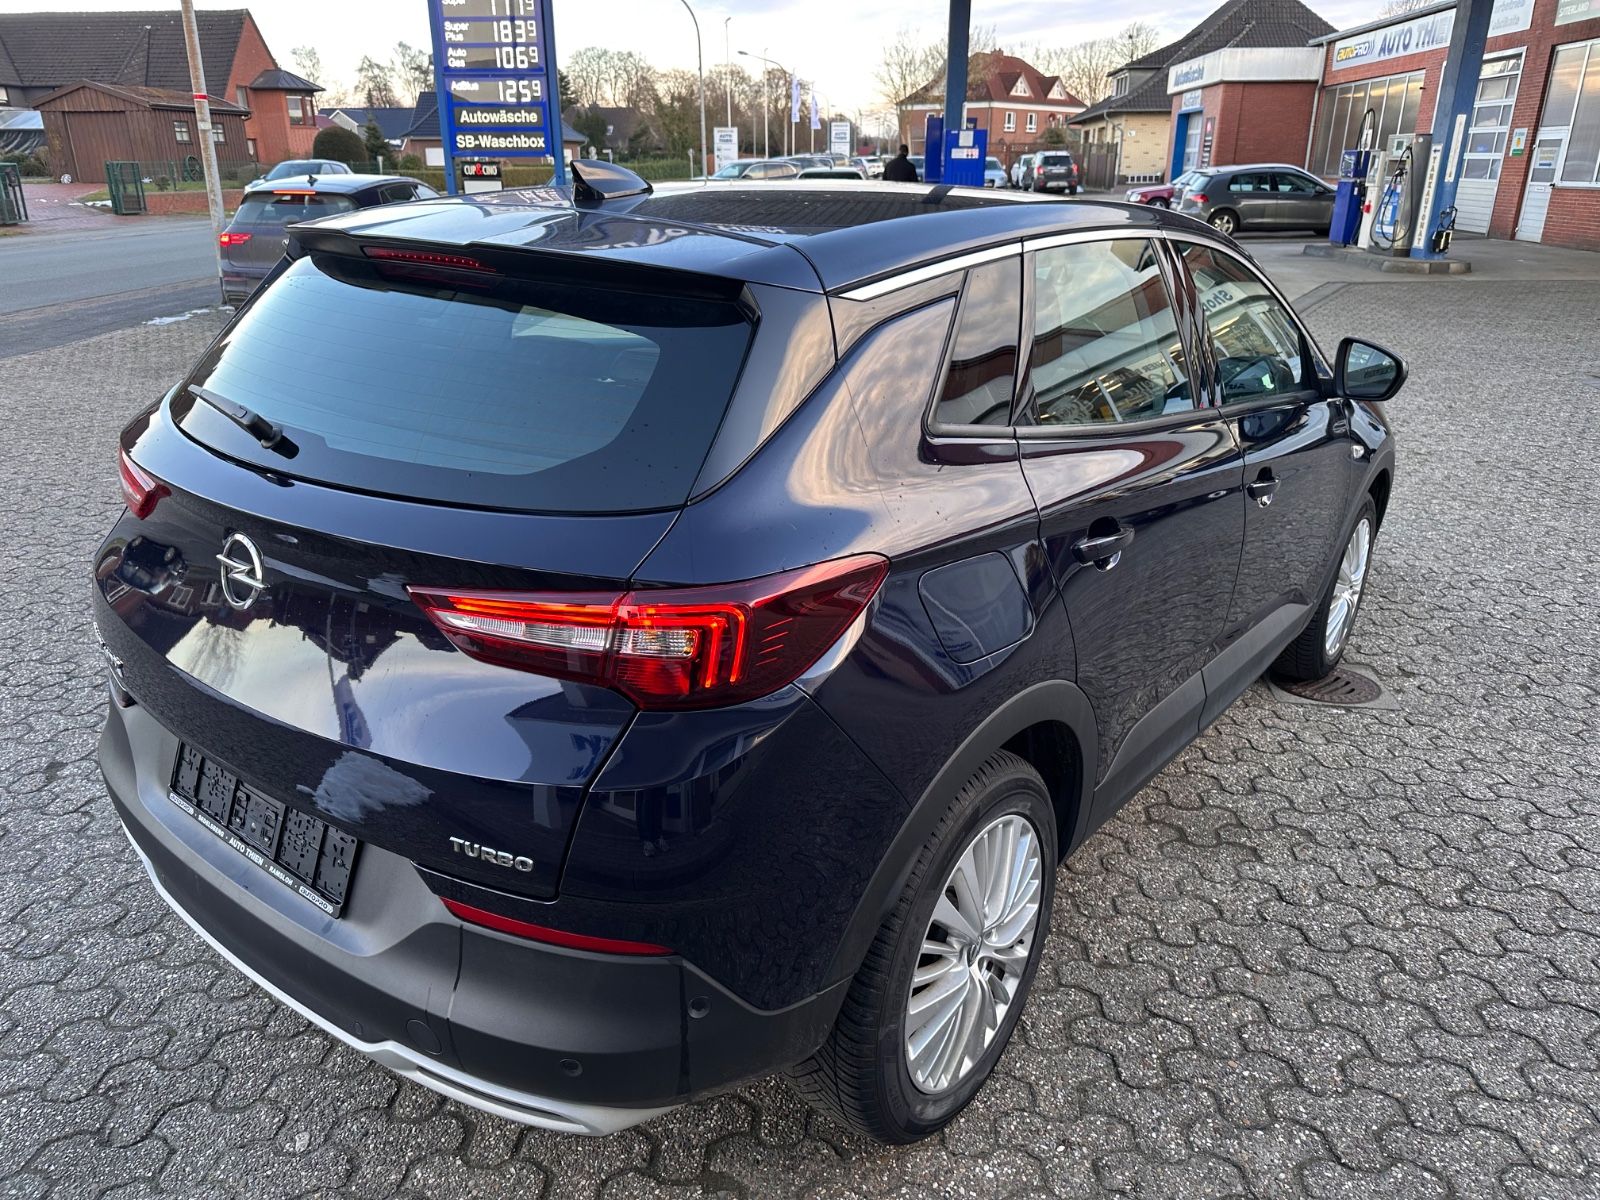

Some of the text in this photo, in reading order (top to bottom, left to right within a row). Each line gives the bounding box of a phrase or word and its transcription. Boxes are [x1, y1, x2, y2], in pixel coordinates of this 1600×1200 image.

[444, 21, 469, 32] Super
[493, 20, 537, 43] 1839
[445, 32, 464, 41] Plus
[1378, 26, 1413, 57] AUTO
[447, 47, 467, 57] Auto
[496, 46, 539, 69] 1069
[448, 58, 466, 68] Gas
[498, 80, 541, 103] 1259
[460, 109, 538, 123] Autowäsche
[456, 134, 546, 148] SB-Waschbox
[228, 837, 246, 853] AUTO
[246, 847, 265, 866] THIEN
[449, 836, 534, 873] TURBO
